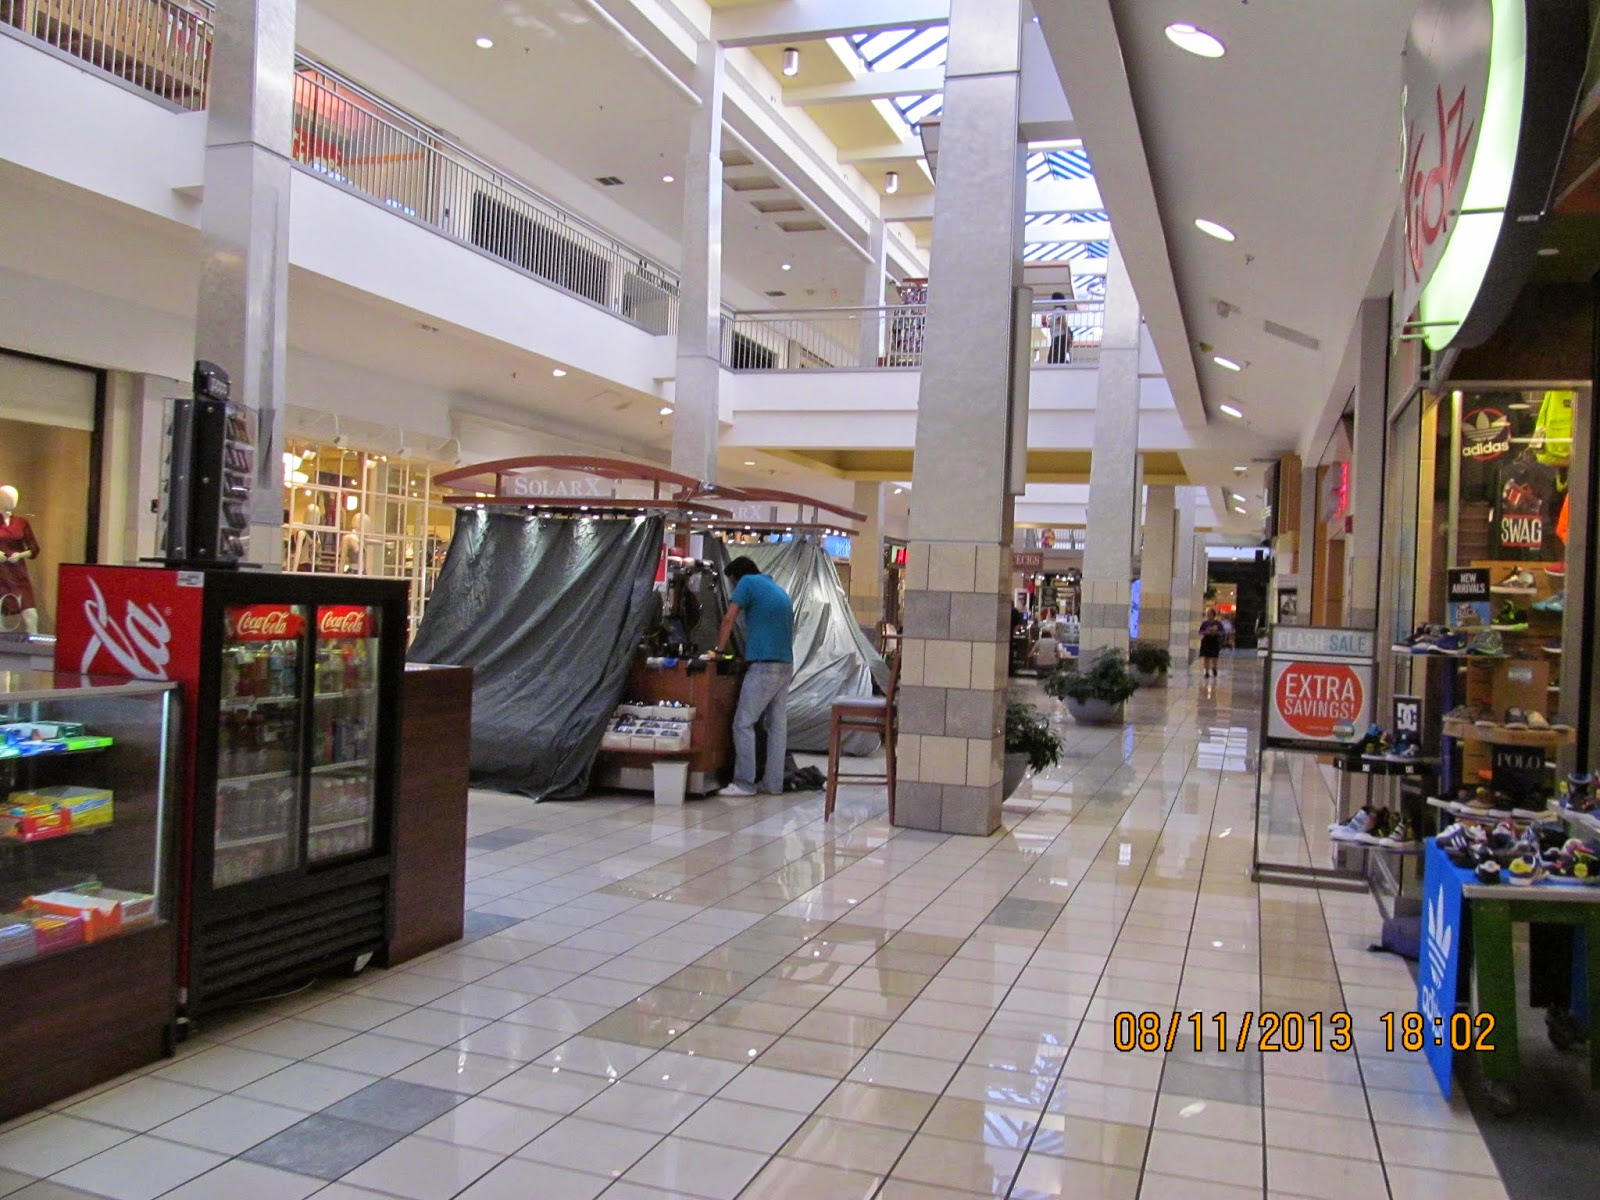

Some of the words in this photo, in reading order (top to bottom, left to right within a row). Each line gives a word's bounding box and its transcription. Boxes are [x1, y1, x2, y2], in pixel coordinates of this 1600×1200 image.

[1462, 441, 1510, 457] adidas
[1501, 517, 1542, 543] SWAG
[1452, 583, 1486, 594] ARRIVALS
[1460, 573, 1477, 584] NEW
[237, 611, 290, 635] Coca-Cola
[320, 611, 366, 633] Coca-Cola
[1277, 630, 1323, 651] FLASH
[1328, 634, 1367, 652] SALE
[1285, 672, 1355, 701] EXTRA
[1283, 698, 1355, 720] SAVINGS!
[1497, 753, 1541, 769] POLO
